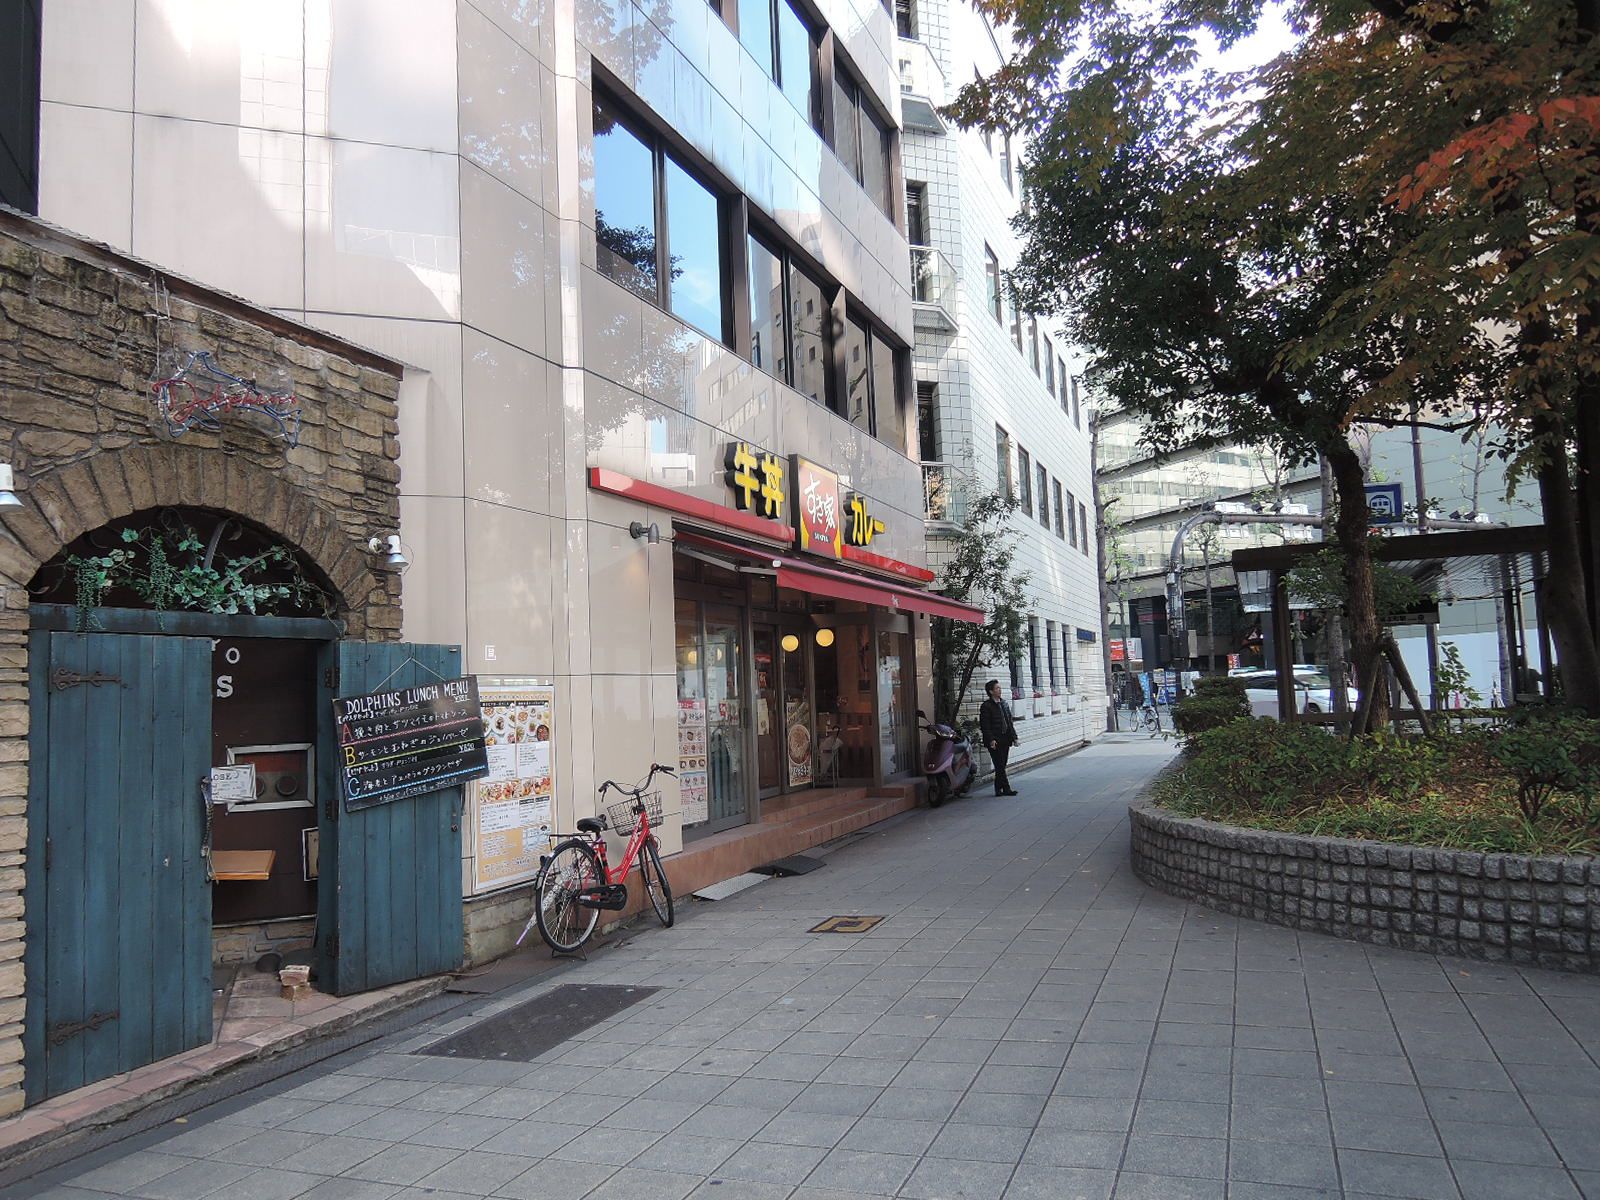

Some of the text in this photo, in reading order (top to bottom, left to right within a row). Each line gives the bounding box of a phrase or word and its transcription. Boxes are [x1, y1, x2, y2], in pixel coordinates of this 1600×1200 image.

[732, 441, 785, 518] 牛丼
[804, 471, 836, 534] すき家
[850, 494, 886, 547] カレー
[346, 692, 401, 715] DOLPHINS
[406, 685, 439, 704] LUNCH
[444, 680, 469, 697] MENU
[342, 722, 354, 743] A
[344, 746, 357, 766] B
